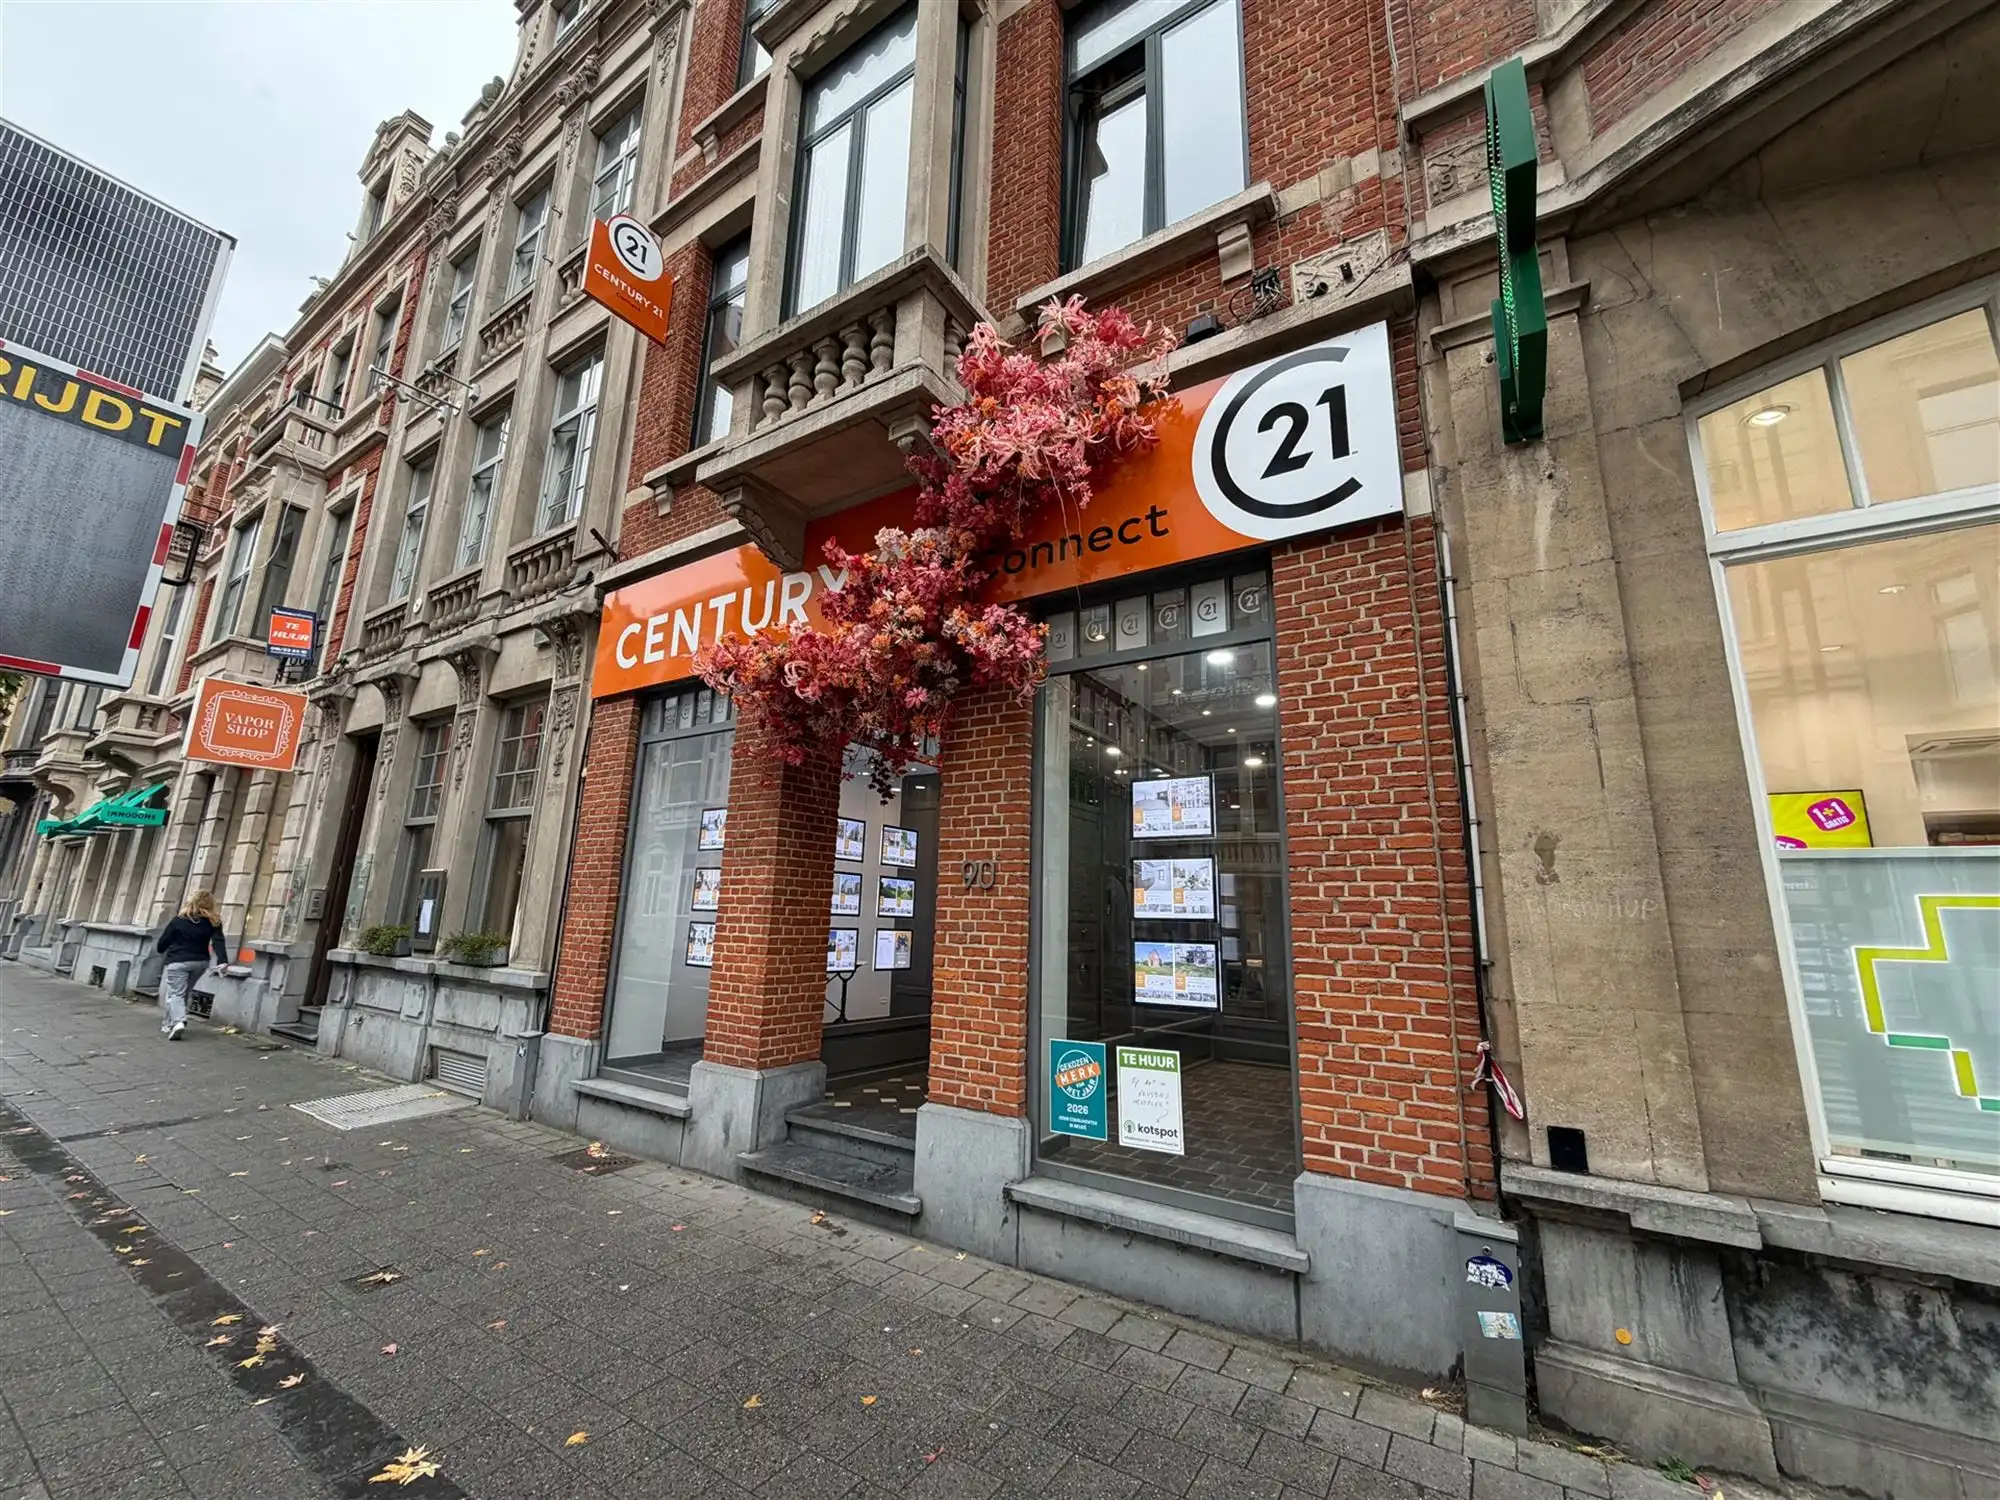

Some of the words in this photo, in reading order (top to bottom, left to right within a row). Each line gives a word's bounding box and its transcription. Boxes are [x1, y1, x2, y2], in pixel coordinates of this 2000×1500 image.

[593, 263, 651, 308] CENTURY
[652, 304, 664, 319] 21
[0, 355, 182, 447] IJDT
[285, 622, 299, 631] TE
[272, 630, 310, 642] HUUR
[225, 712, 275, 730] VAPOR
[226, 724, 268, 738] SHOP
[1812, 801, 1845, 822] 1+1
[961, 859, 995, 889] 90
[1059, 1056, 1090, 1072] GEKOZEN
[1122, 1052, 1137, 1065] TE
[1139, 1054, 1175, 1069] HUUR
[1060, 1064, 1096, 1085] MERK
[1066, 1085, 1081, 1098] HET
[1081, 1078, 1097, 1098] JAAR
[1066, 1102, 1090, 1115] 2026
[1137, 1122, 1179, 1139] kotspot
